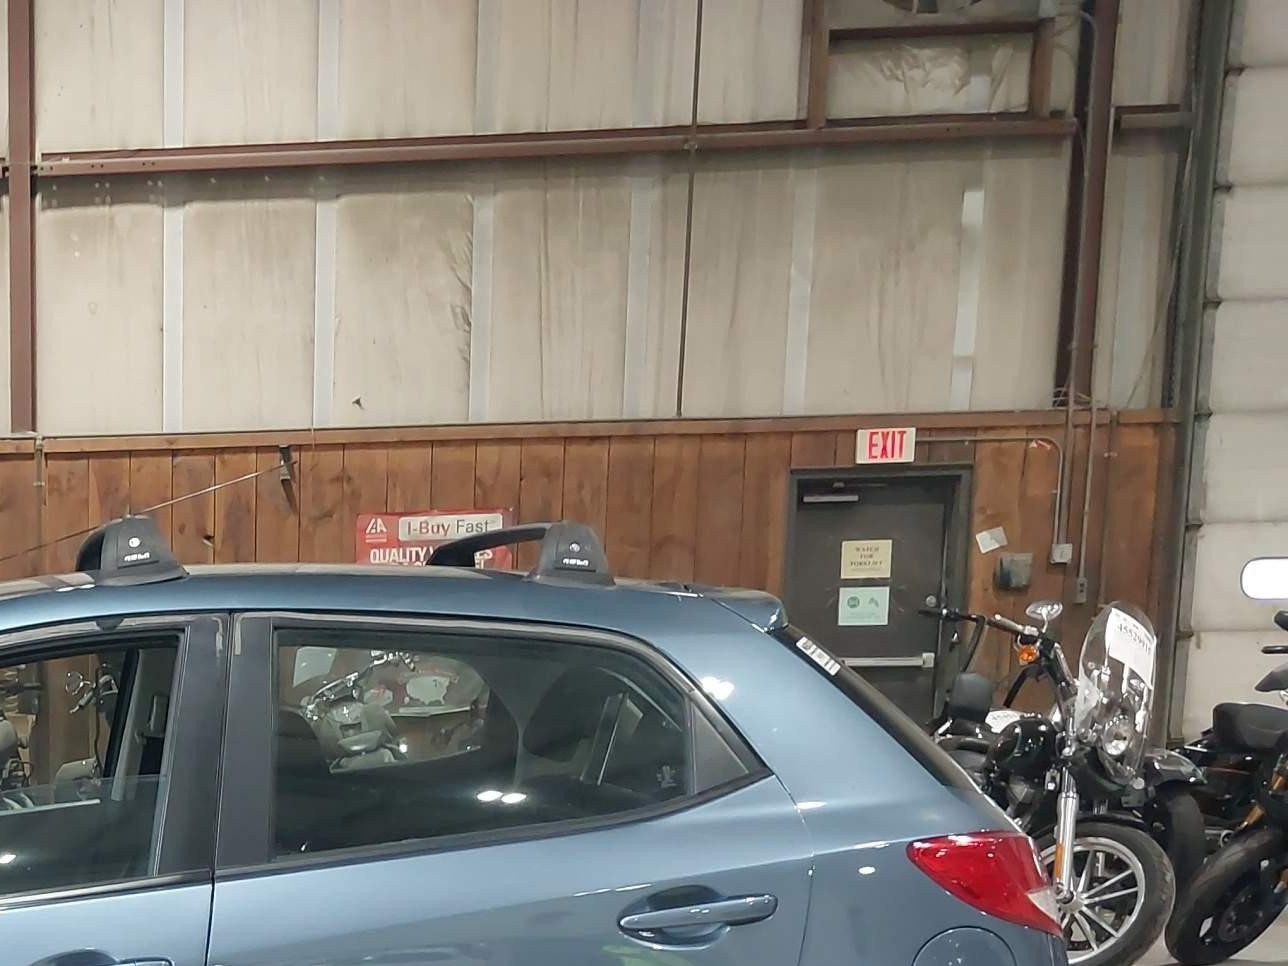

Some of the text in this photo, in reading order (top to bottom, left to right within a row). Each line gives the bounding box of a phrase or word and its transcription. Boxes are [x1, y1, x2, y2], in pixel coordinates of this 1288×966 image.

[868, 431, 906, 459] EXIT
[407, 519, 489, 536] I-Buy Fast
[369, 548, 427, 564] QUALITY
